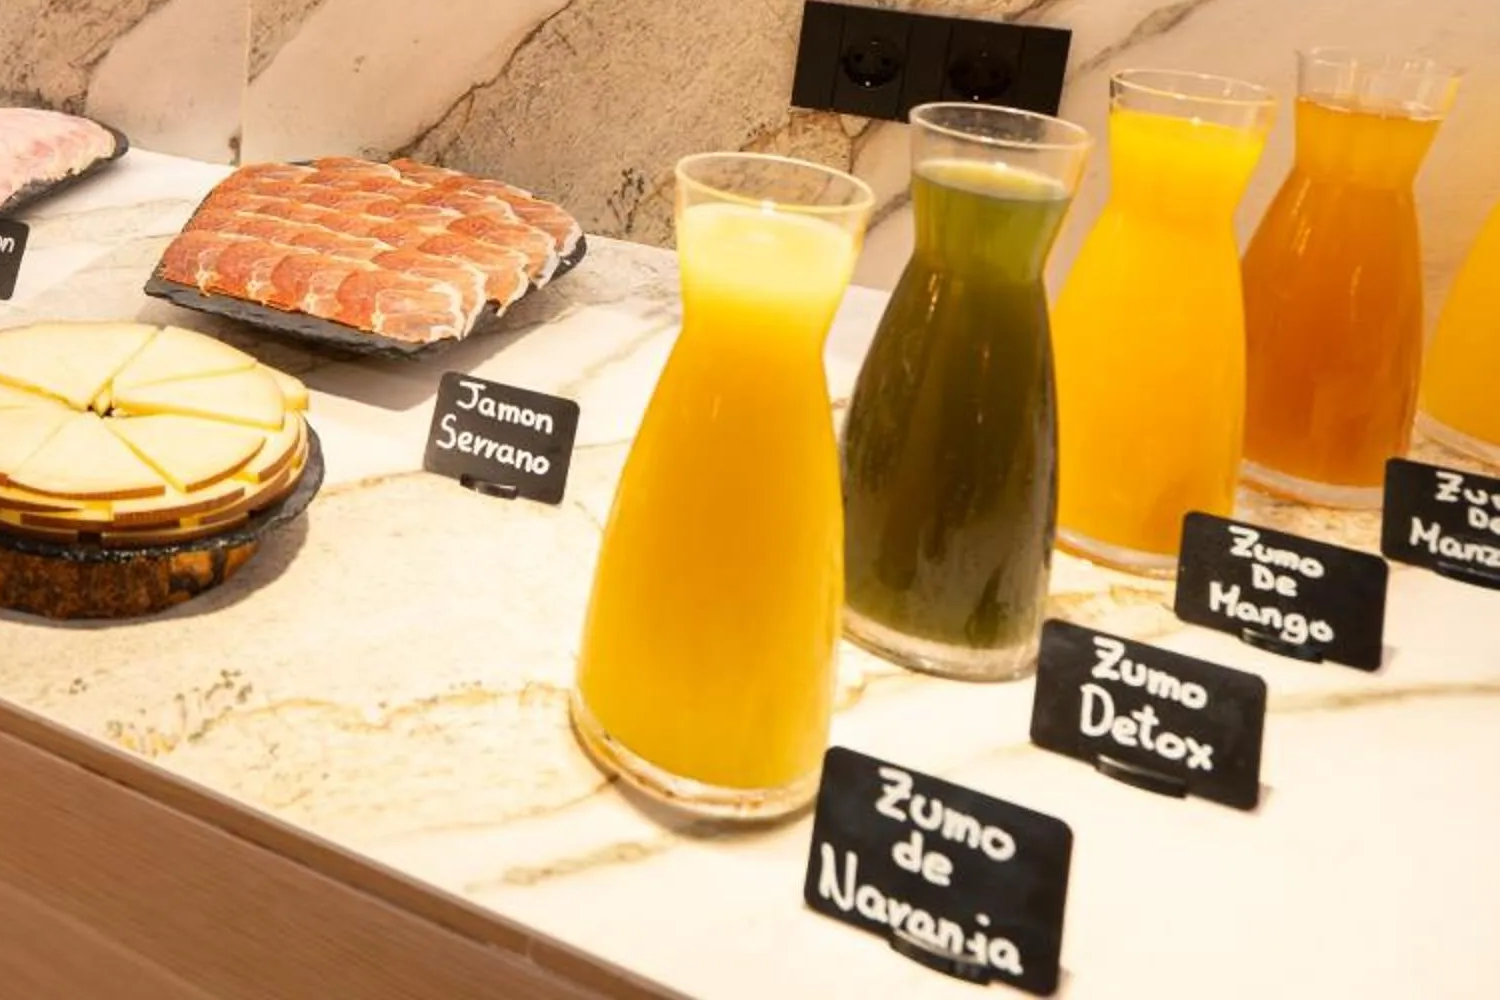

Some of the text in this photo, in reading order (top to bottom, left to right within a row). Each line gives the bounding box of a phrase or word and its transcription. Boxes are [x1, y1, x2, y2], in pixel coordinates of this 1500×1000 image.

[456, 380, 554, 435] Jamon
[435, 412, 551, 476] Serrano
[1227, 524, 1325, 579] Zumo
[1251, 562, 1298, 597] De
[1208, 581, 1335, 645] Mango
[1091, 635, 1208, 710] Zumo
[1079, 682, 1214, 771] Detox
[874, 765, 1017, 862] Zumo
[891, 829, 954, 887] de
[817, 841, 1024, 976] Naranja
